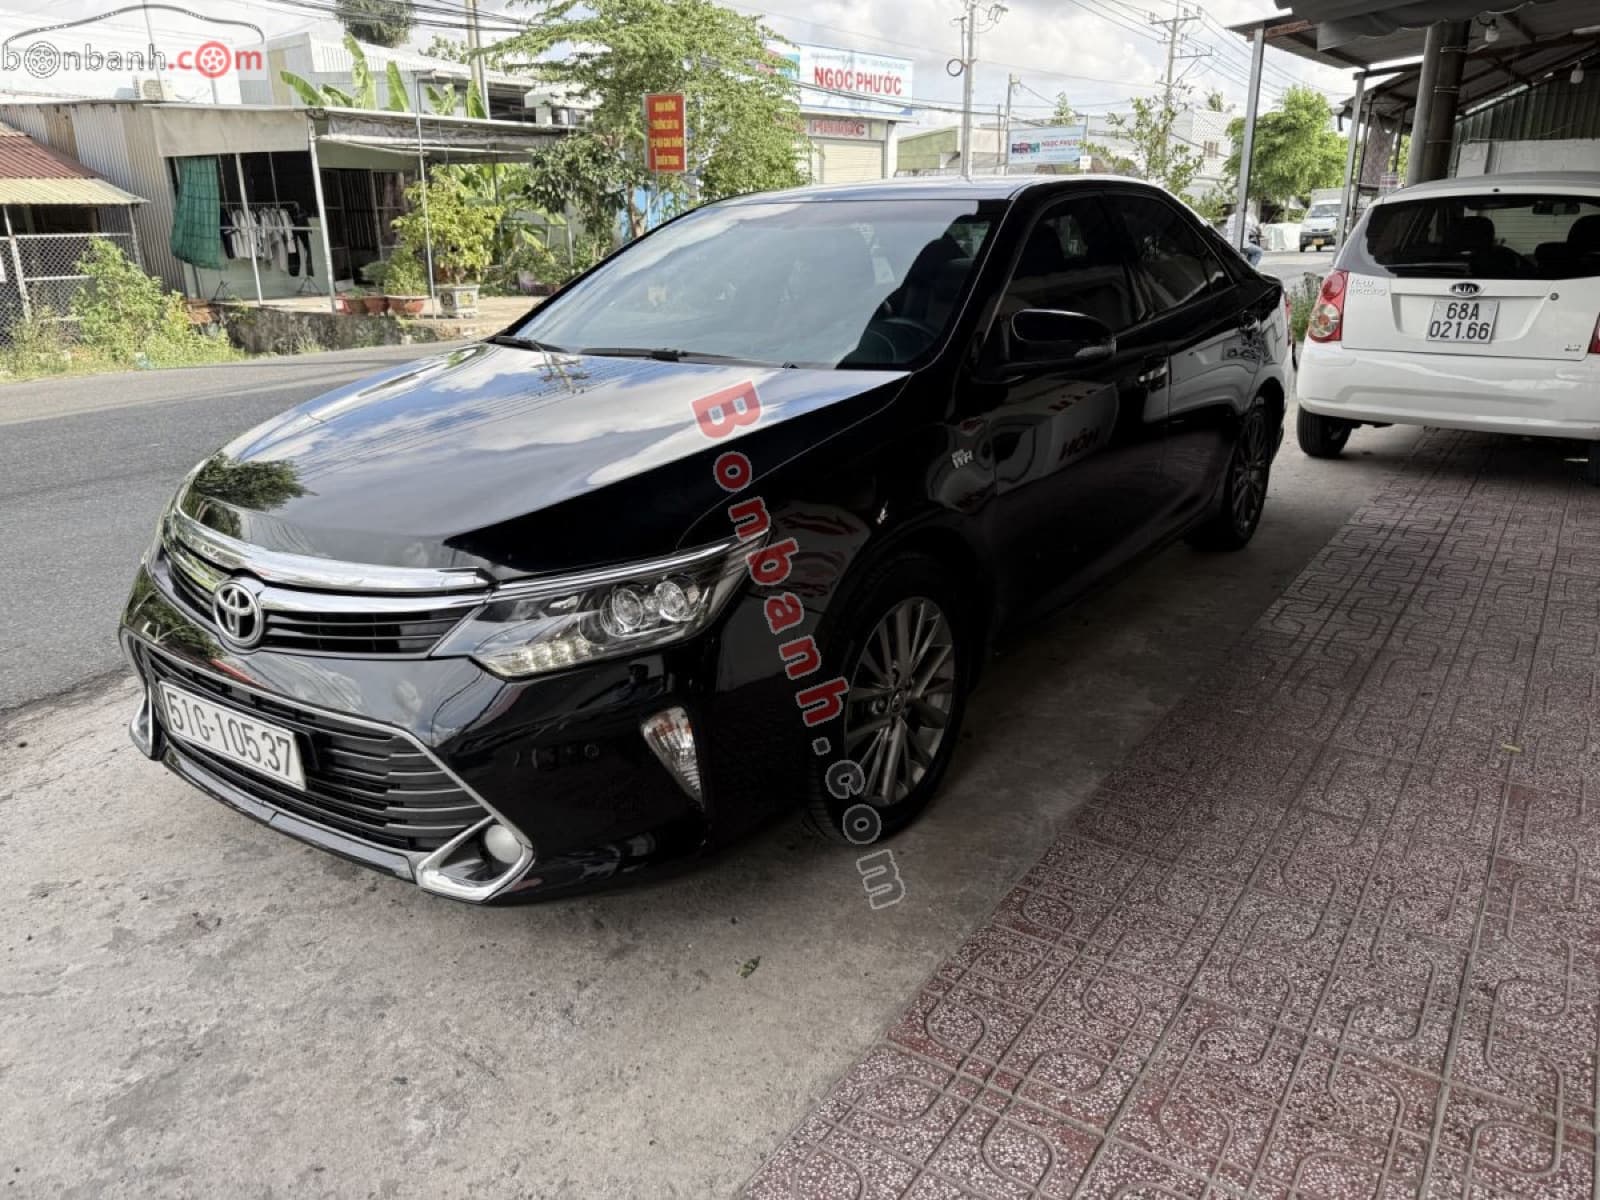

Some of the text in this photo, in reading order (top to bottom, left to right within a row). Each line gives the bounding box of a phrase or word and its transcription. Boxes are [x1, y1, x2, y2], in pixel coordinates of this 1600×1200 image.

[1455, 284, 1475, 293] KIA
[1446, 302, 1480, 320] 68A
[1429, 320, 1490, 340] 021.66
